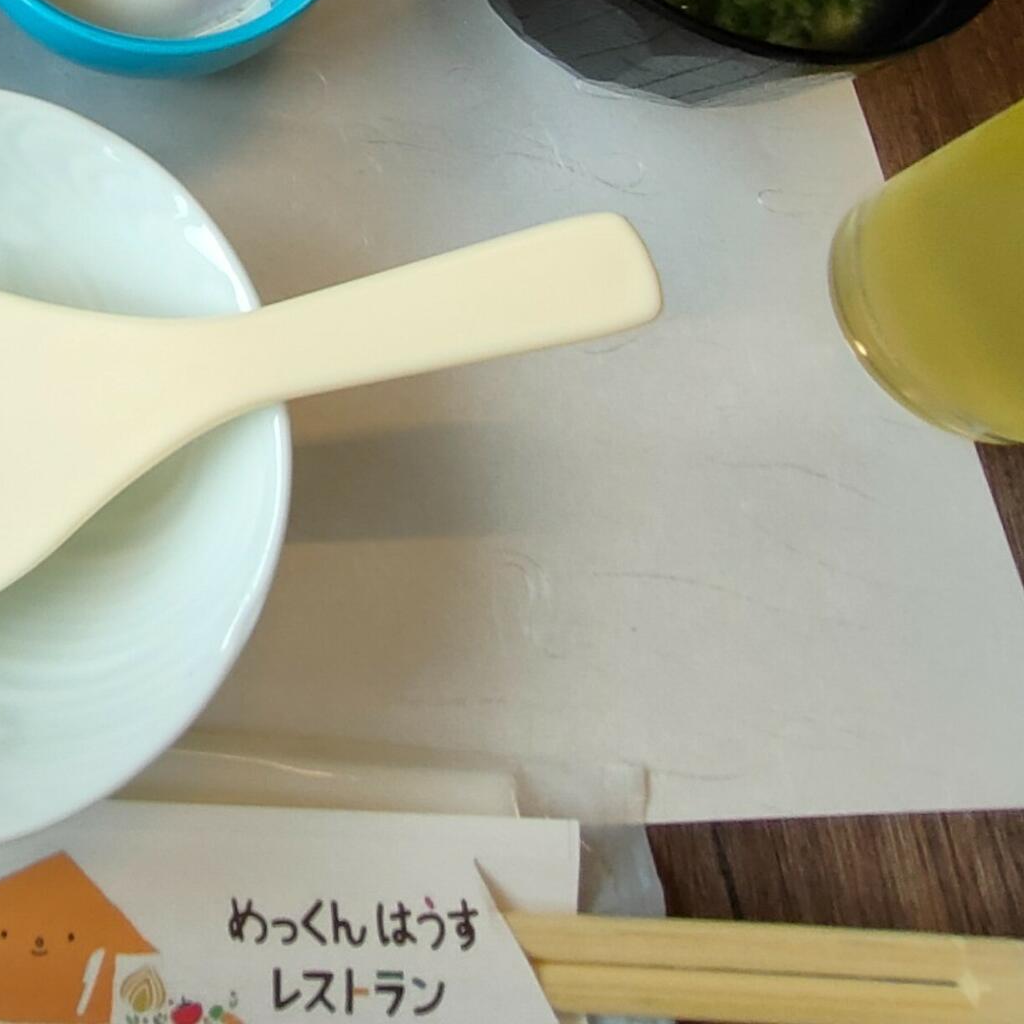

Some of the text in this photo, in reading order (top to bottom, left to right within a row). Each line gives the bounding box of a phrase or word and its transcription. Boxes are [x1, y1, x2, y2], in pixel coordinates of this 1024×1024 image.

[273, 967, 445, 1017] レストラン
